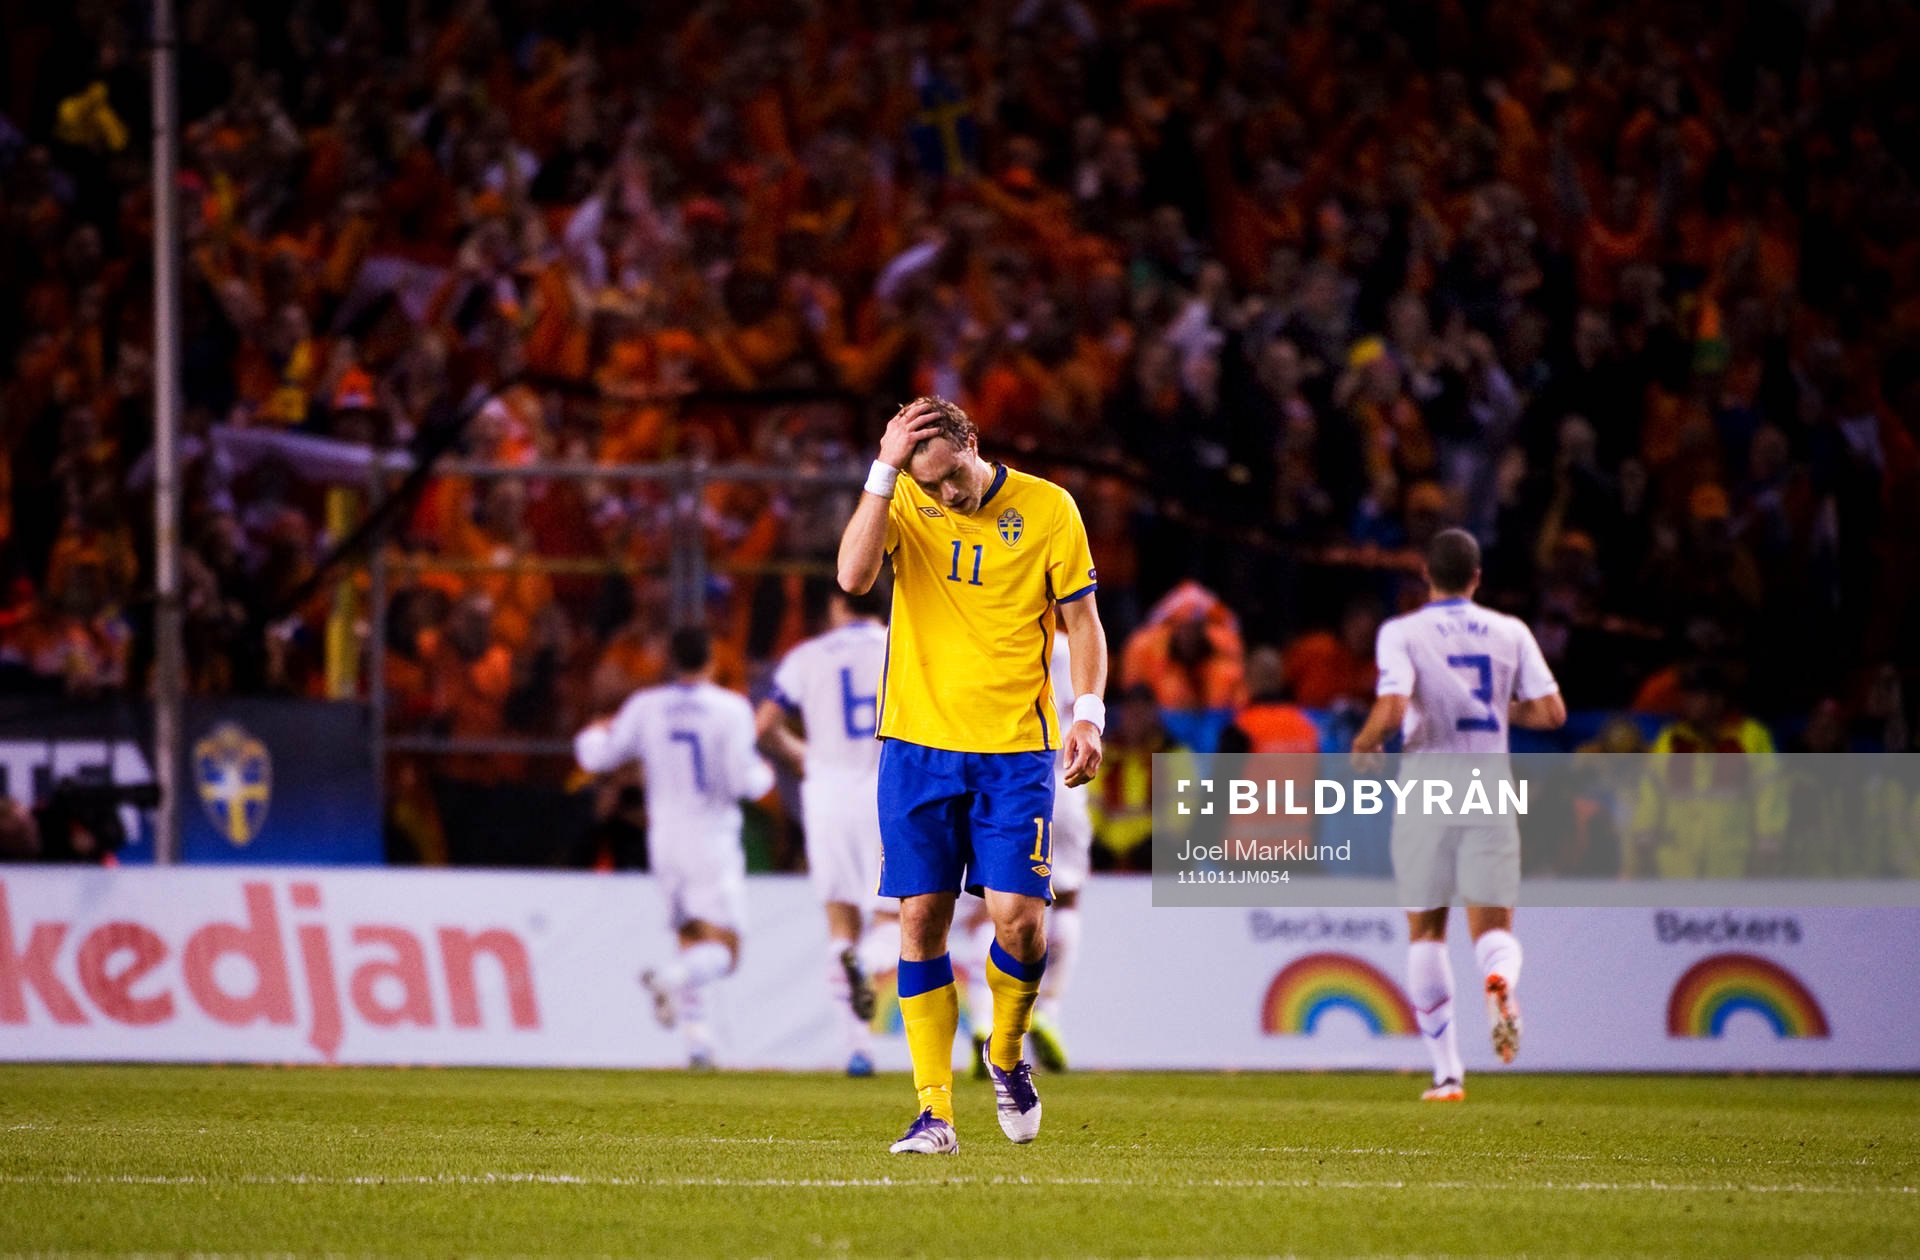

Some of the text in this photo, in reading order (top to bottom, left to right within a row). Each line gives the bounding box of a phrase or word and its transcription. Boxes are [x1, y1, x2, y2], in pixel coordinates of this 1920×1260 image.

[947, 540, 983, 585] 11
[841, 667, 877, 740] 6
[1447, 654, 1499, 732] 3
[671, 731, 705, 793] 7
[1249, 909, 1393, 942] Beckers
[1655, 912, 1802, 943] Beckers
[0, 882, 541, 1062] kedjan
